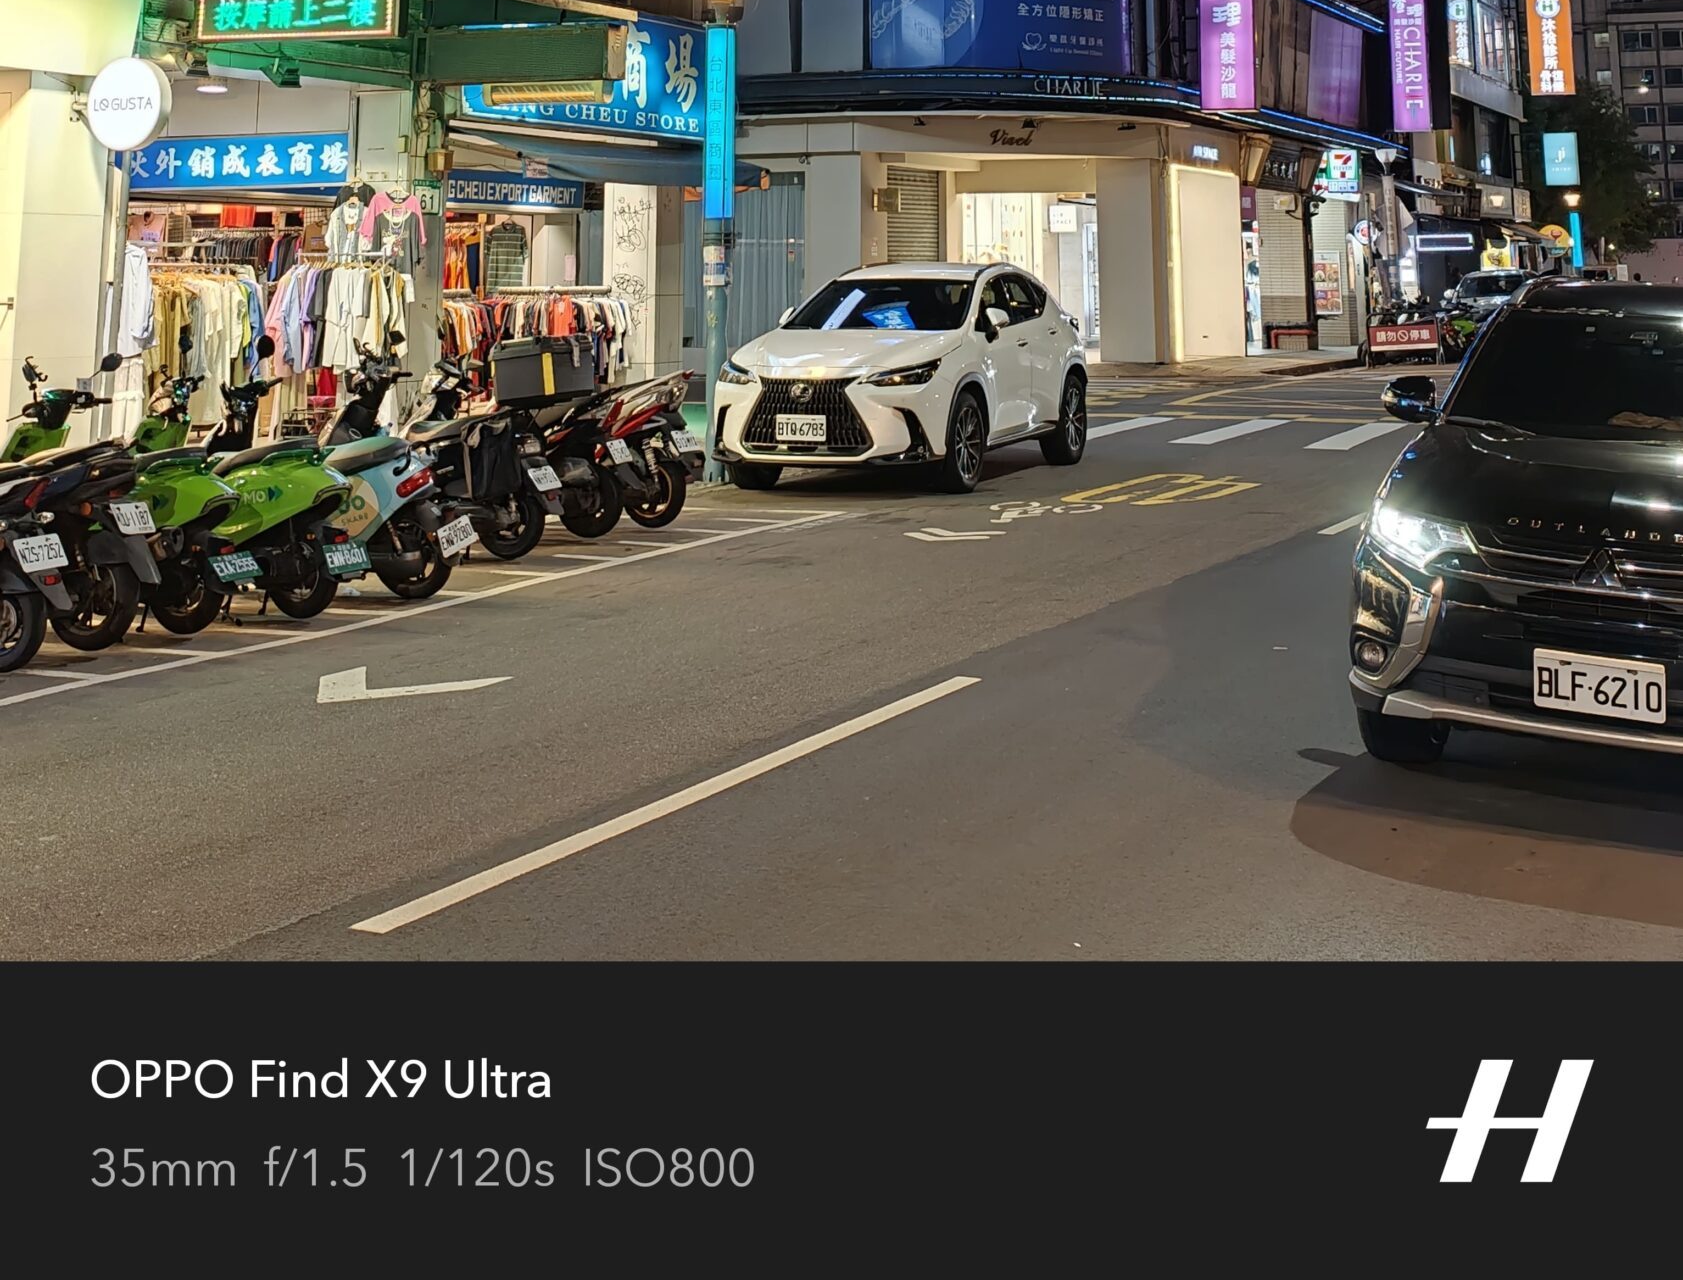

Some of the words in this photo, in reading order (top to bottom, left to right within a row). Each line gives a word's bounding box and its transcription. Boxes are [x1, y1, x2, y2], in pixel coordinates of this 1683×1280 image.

[1017, 3, 1105, 22] 全方位隱形矯正
[1220, 32, 1237, 99] 美髮沙龍
[565, 103, 627, 124] CHEU
[636, 113, 699, 133] STORE
[421, 194, 434, 210] 61
[456, 180, 486, 199] CHEU
[487, 183, 528, 202] EXPORT
[529, 185, 577, 205] GARMENT
[18, 543, 64, 565] NZS-7252
